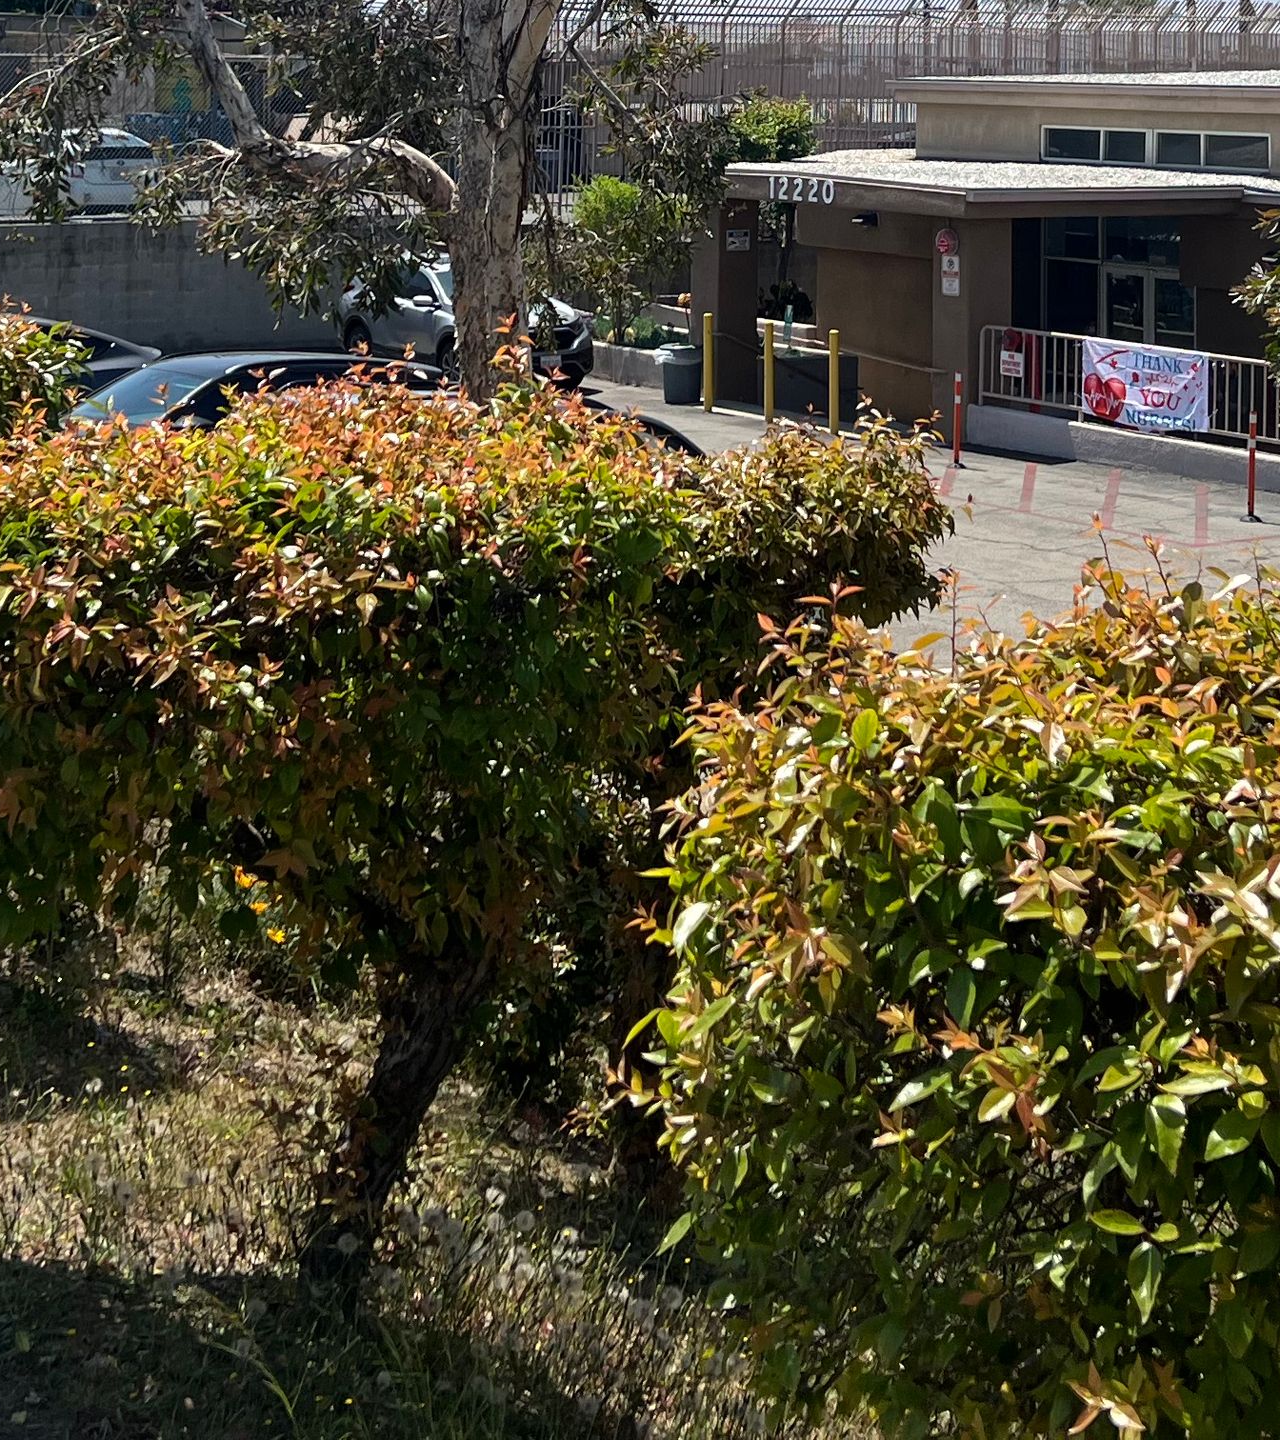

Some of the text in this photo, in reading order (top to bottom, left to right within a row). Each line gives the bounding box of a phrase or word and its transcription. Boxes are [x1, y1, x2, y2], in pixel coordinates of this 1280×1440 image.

[768, 176, 835, 205] 12220
[1133, 352, 1183, 374] THANK
[1140, 388, 1182, 410] YOU
